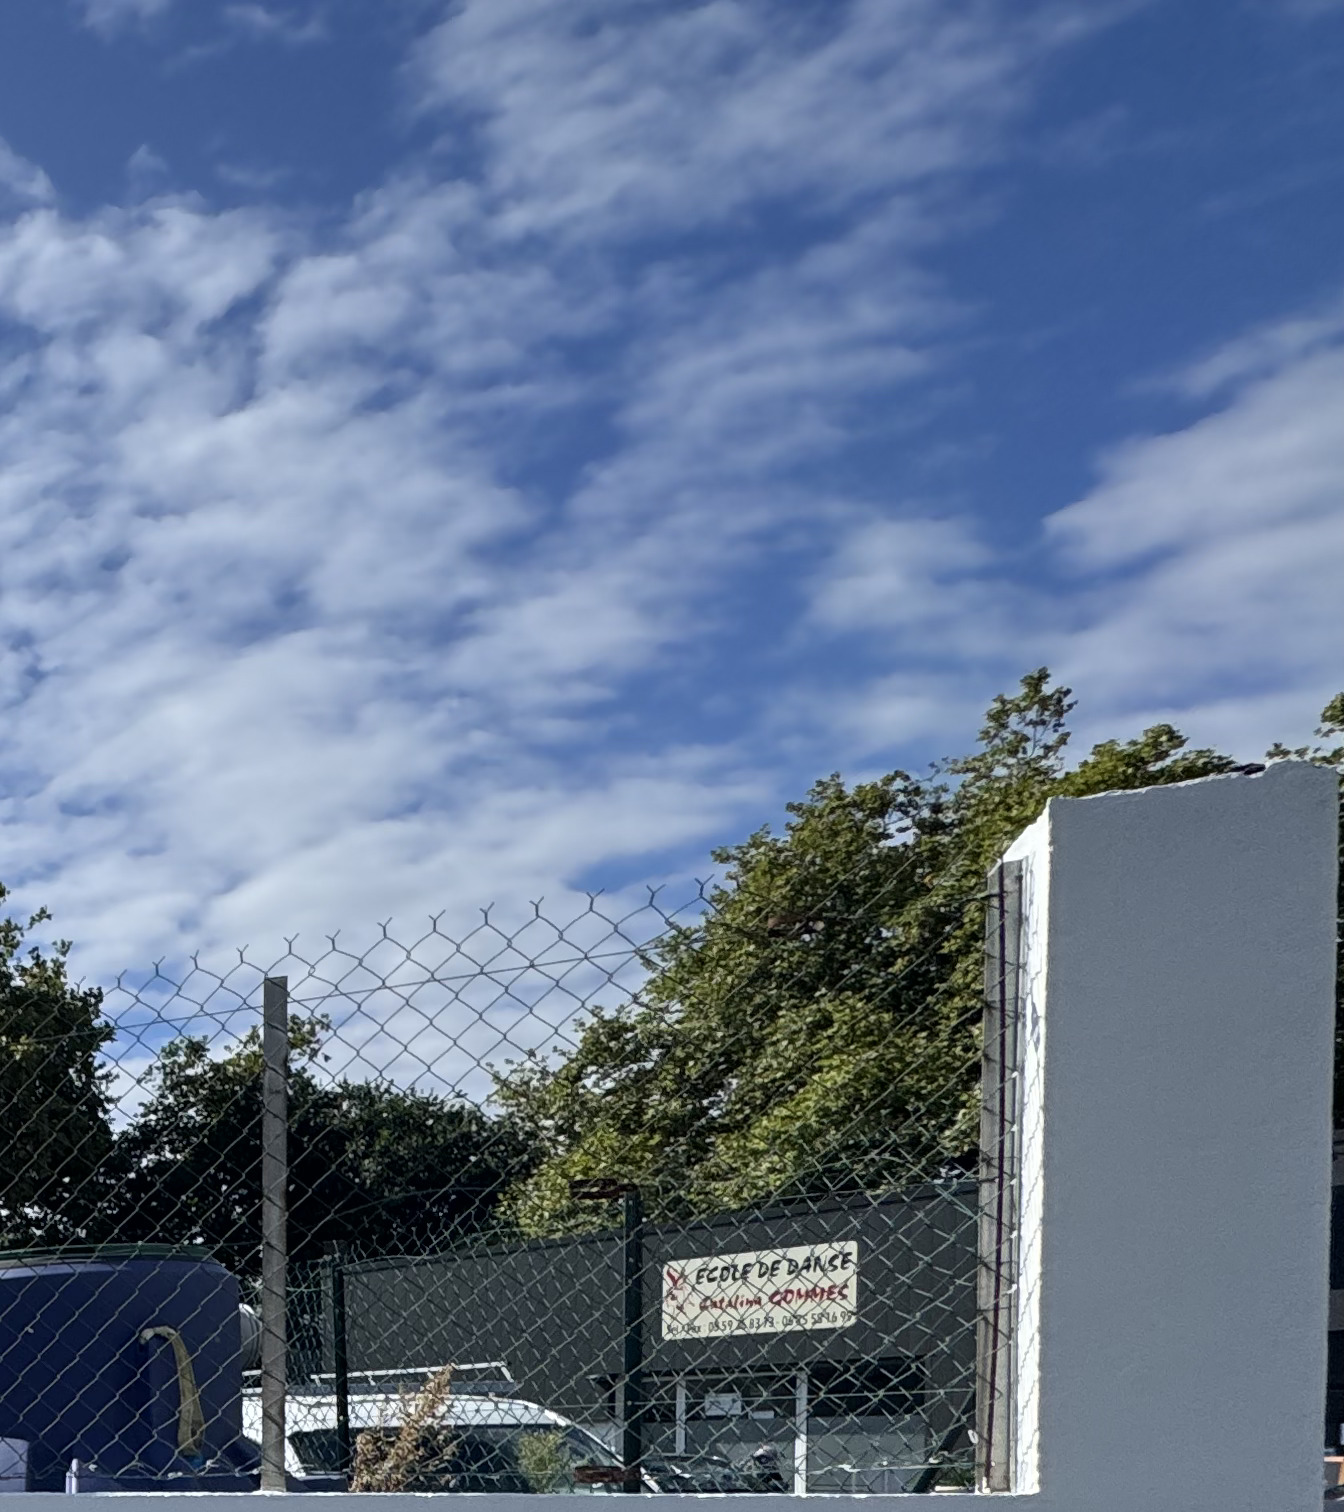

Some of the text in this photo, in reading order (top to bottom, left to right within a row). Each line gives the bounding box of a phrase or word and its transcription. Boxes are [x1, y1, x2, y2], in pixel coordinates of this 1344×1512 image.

[696, 1252, 852, 1285] ECOLE DE DANSE
